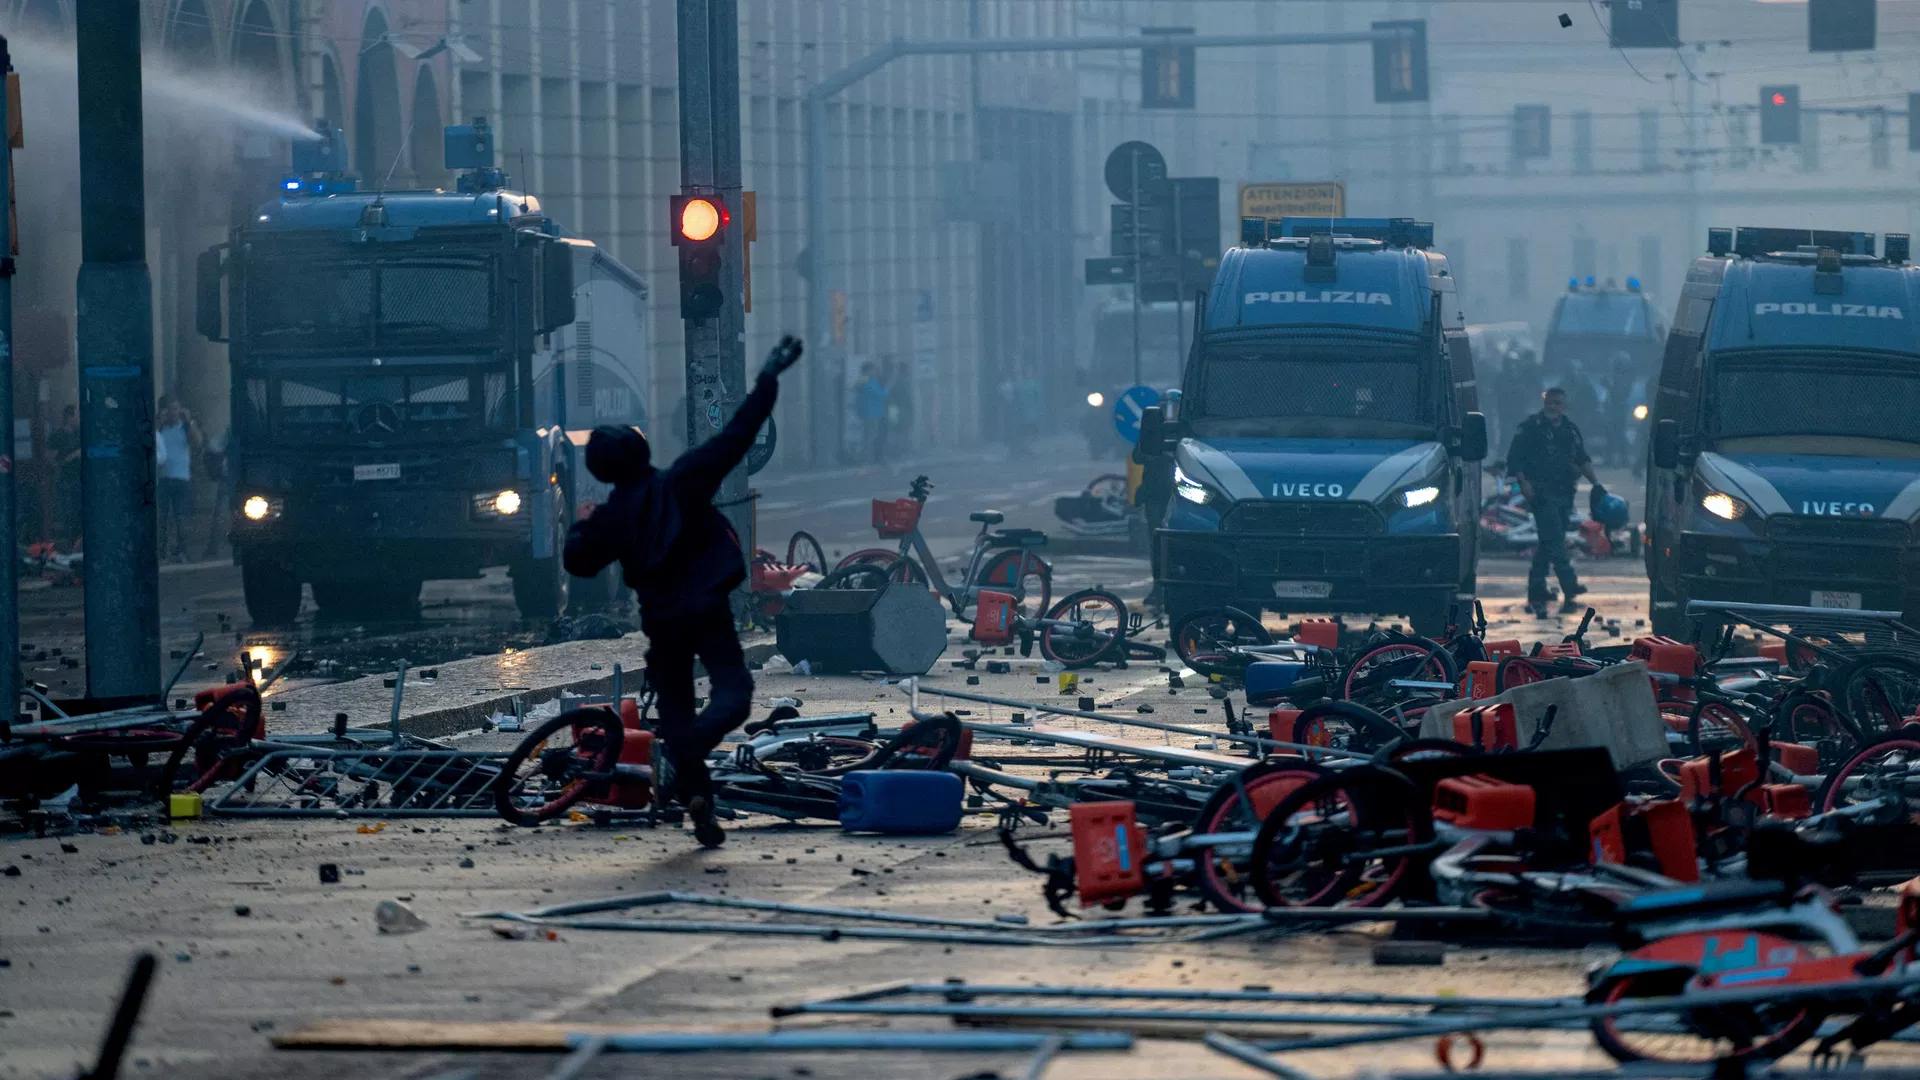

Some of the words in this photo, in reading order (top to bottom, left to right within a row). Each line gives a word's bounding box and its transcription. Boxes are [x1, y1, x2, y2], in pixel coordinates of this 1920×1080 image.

[1244, 291, 1393, 305] POLIZIA
[1755, 302, 1904, 320] POLIZIA
[1272, 483, 1343, 498] IVECO
[1802, 501, 1875, 516] IVECO
